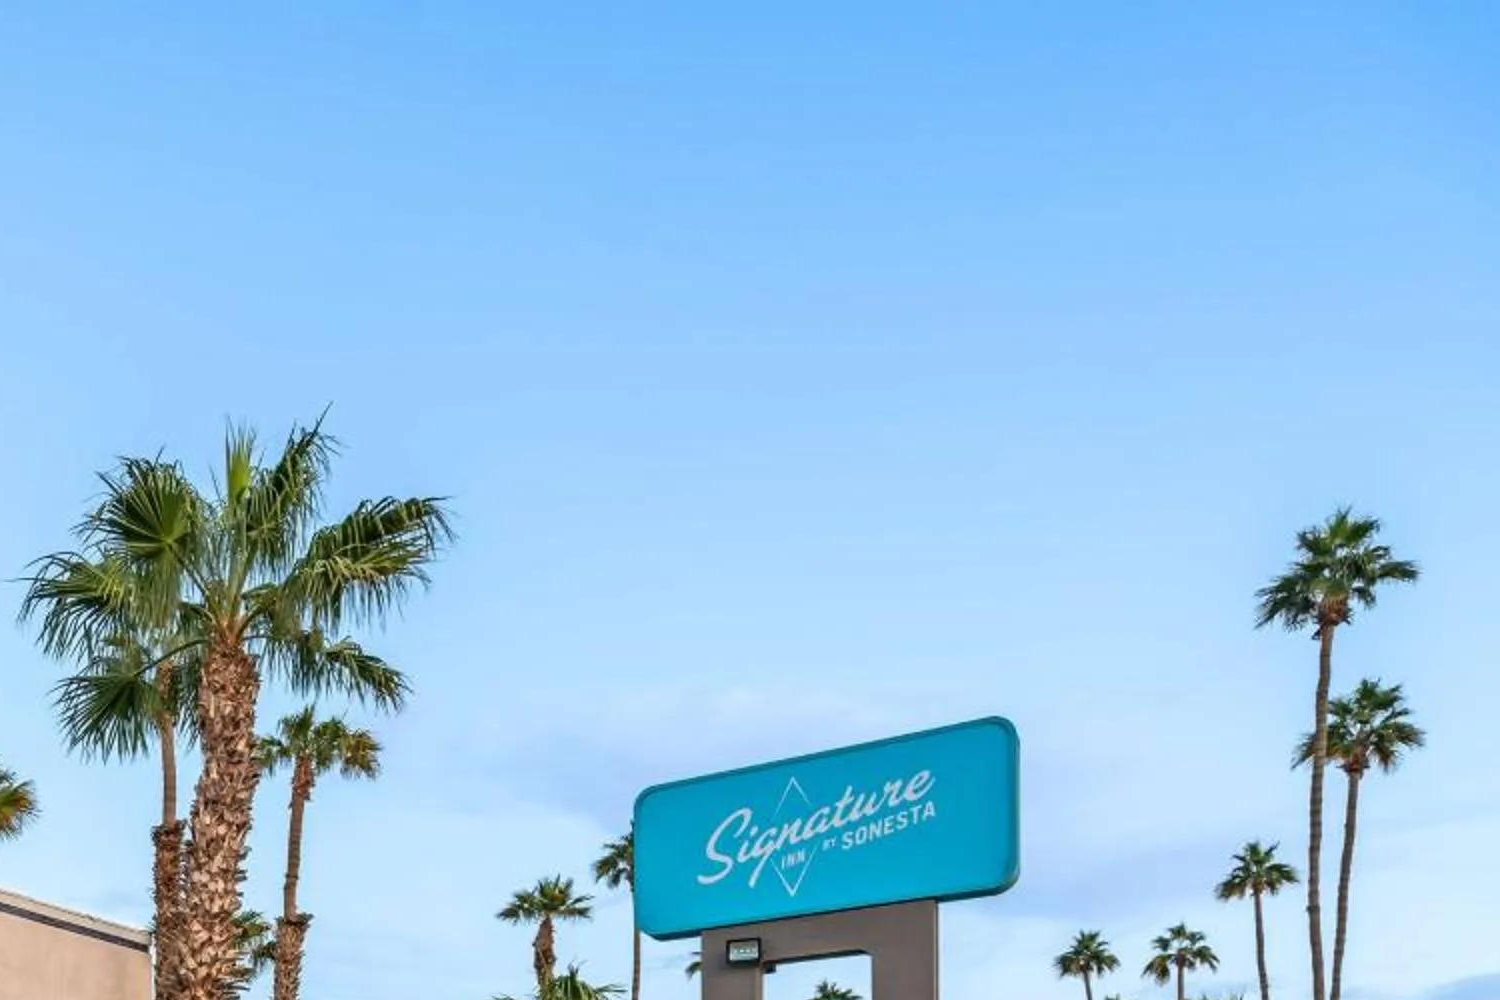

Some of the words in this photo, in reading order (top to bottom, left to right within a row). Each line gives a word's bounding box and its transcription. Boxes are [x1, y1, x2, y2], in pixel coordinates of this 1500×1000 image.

[697, 769, 935, 888] Signature
[781, 849, 806, 870] INN
[822, 836, 837, 851] BY
[841, 800, 936, 850] SONESTA
